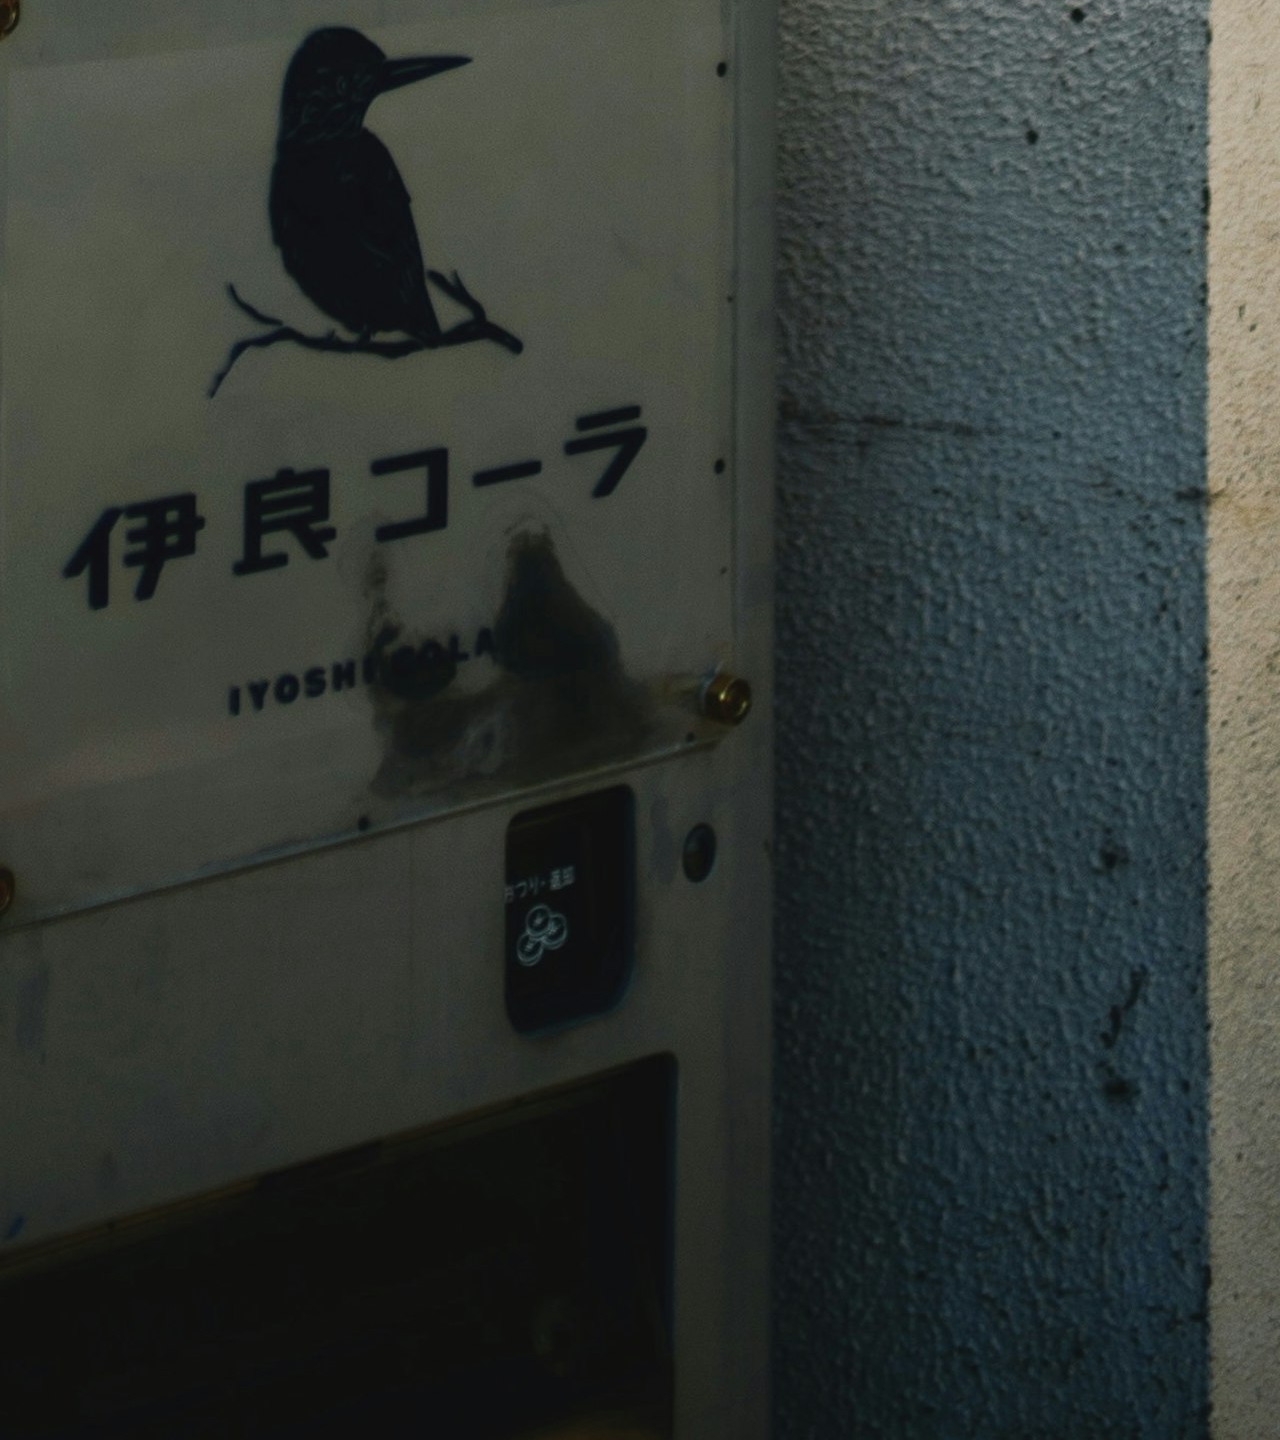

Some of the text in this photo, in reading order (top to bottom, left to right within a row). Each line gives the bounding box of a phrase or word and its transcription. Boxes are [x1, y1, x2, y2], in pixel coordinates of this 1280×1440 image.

[63, 405, 648, 611] 伊良コーラ
[227, 653, 377, 717] IYOSHI
